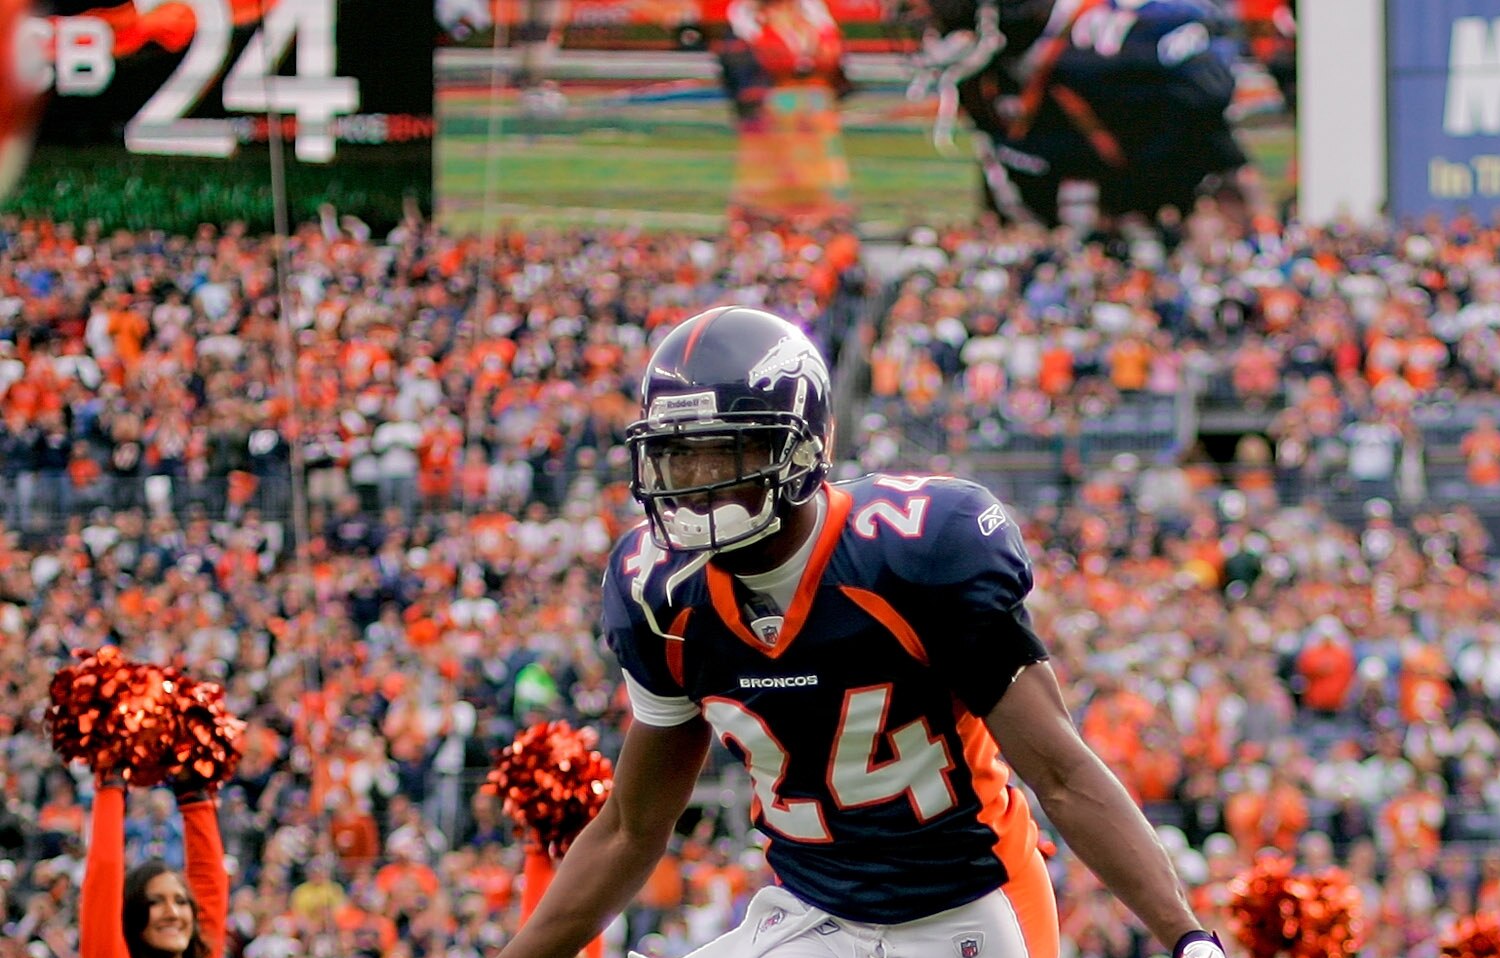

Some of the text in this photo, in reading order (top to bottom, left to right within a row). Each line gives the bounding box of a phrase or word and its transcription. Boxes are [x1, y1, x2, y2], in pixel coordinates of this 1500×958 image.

[1430, 157, 1471, 196] In
[739, 675, 818, 688] BRONCOS
[701, 683, 957, 844] 24
